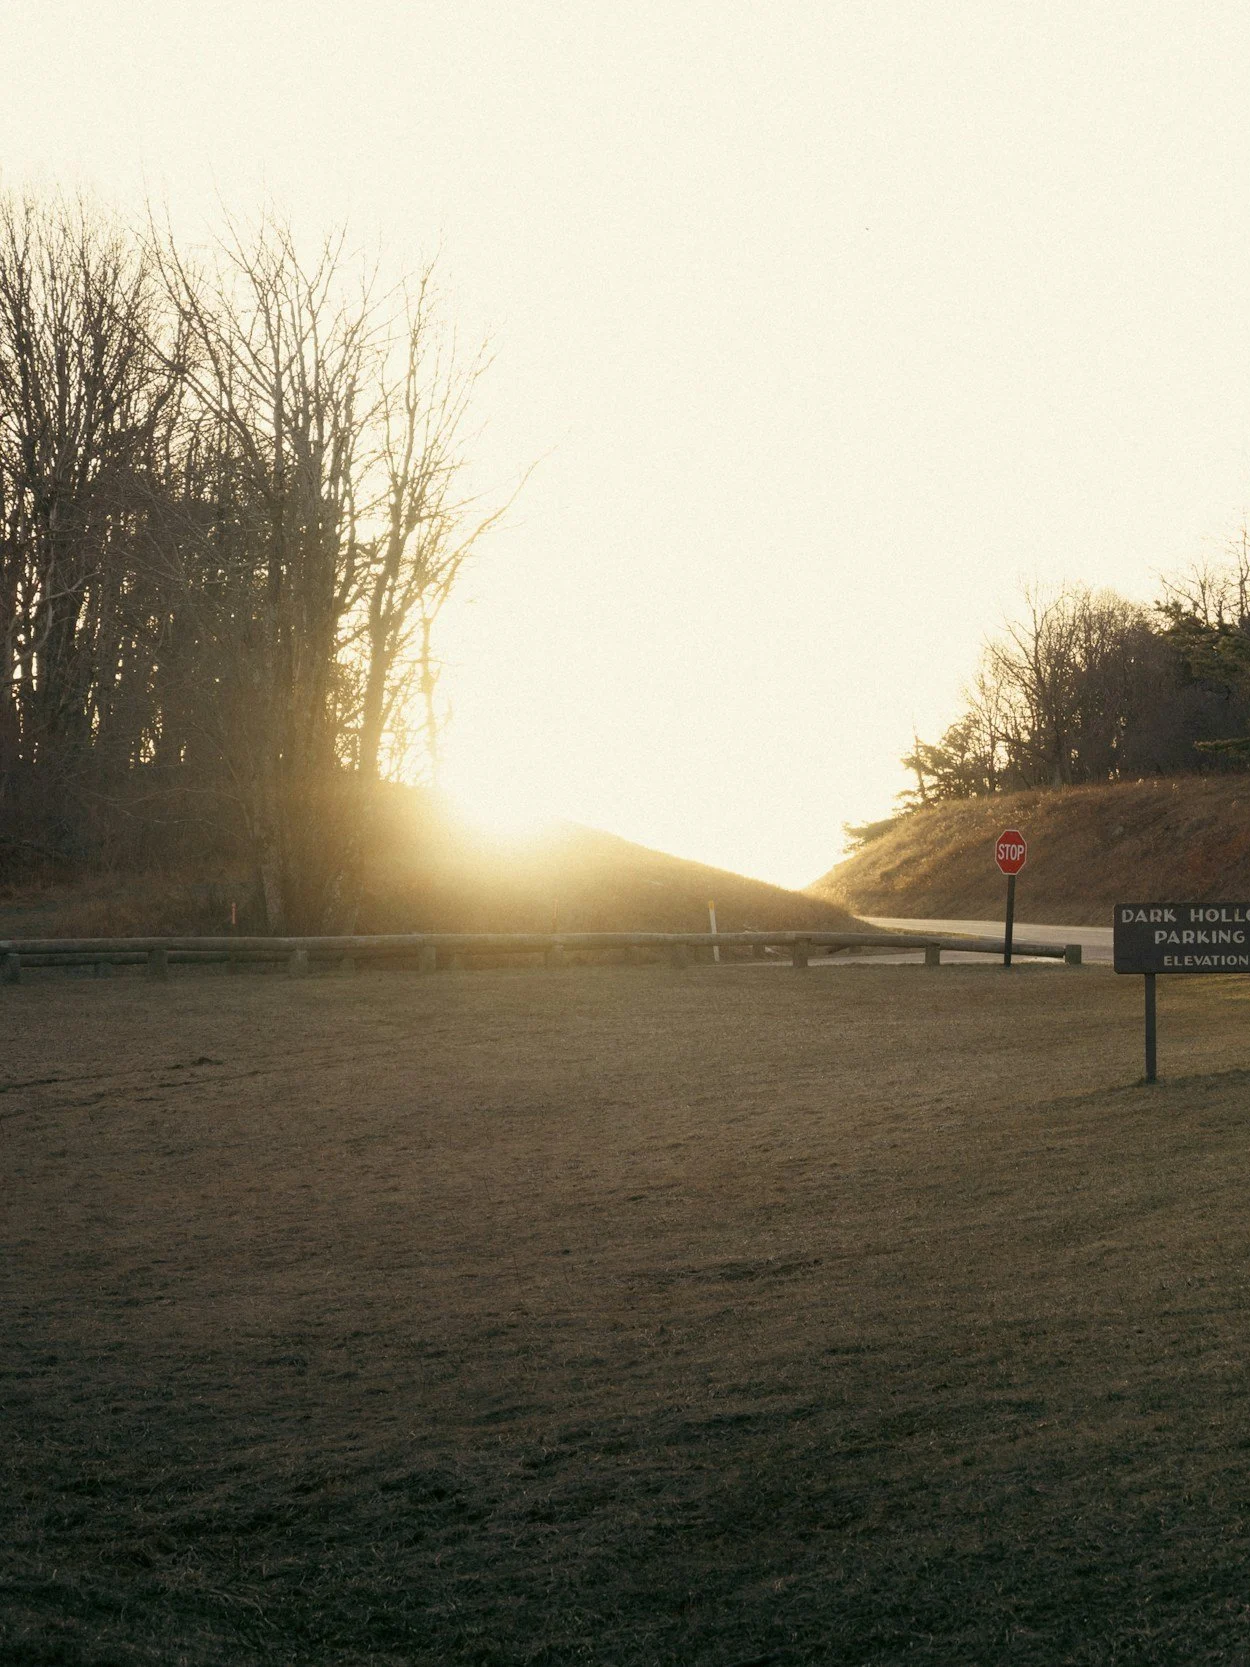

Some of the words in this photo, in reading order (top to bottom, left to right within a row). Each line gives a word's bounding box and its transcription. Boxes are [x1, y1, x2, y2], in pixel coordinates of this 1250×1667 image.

[998, 844, 1024, 860] STOP
[1121, 909, 1177, 923] DARK
[1154, 930, 1245, 945] PARKING
[1164, 955, 1249, 966] ELEVATION
